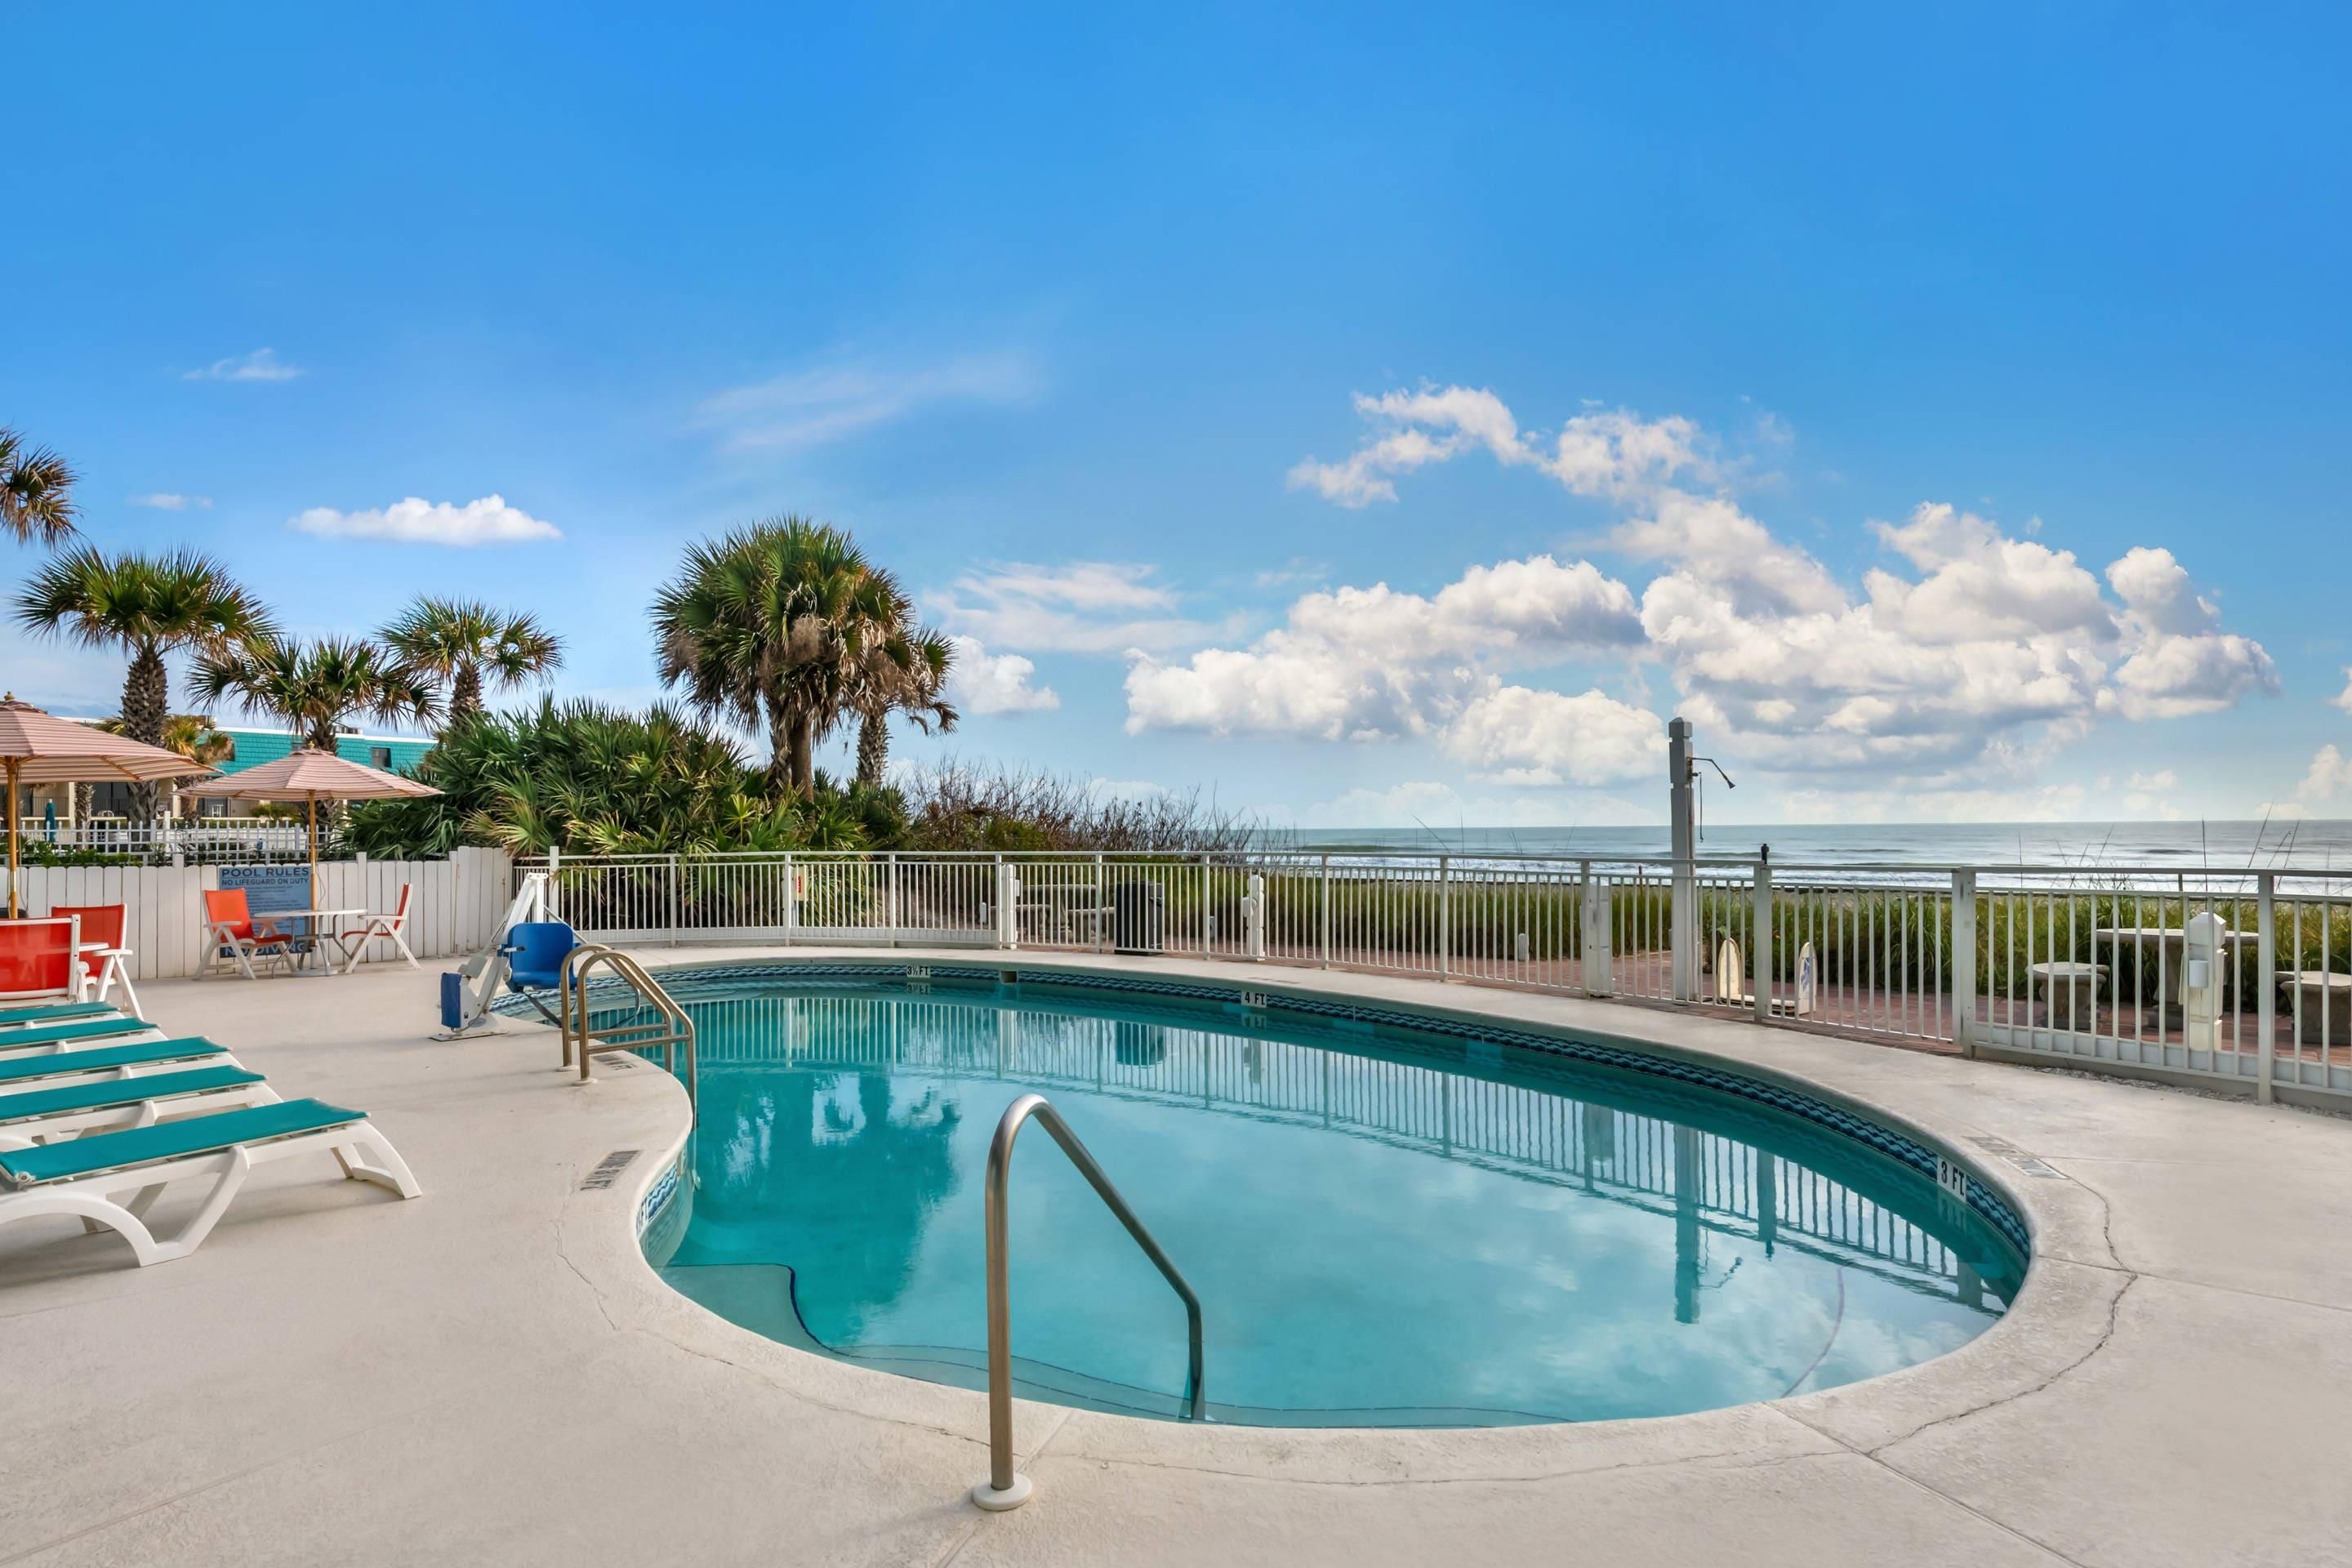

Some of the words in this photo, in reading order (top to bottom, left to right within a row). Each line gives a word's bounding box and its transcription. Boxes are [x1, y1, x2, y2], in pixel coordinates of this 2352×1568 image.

[221, 868, 261, 877] POOL
[266, 867, 310, 876] RULES
[1245, 991, 1250, 1003] 4
[1941, 1160, 1948, 1184] 3
